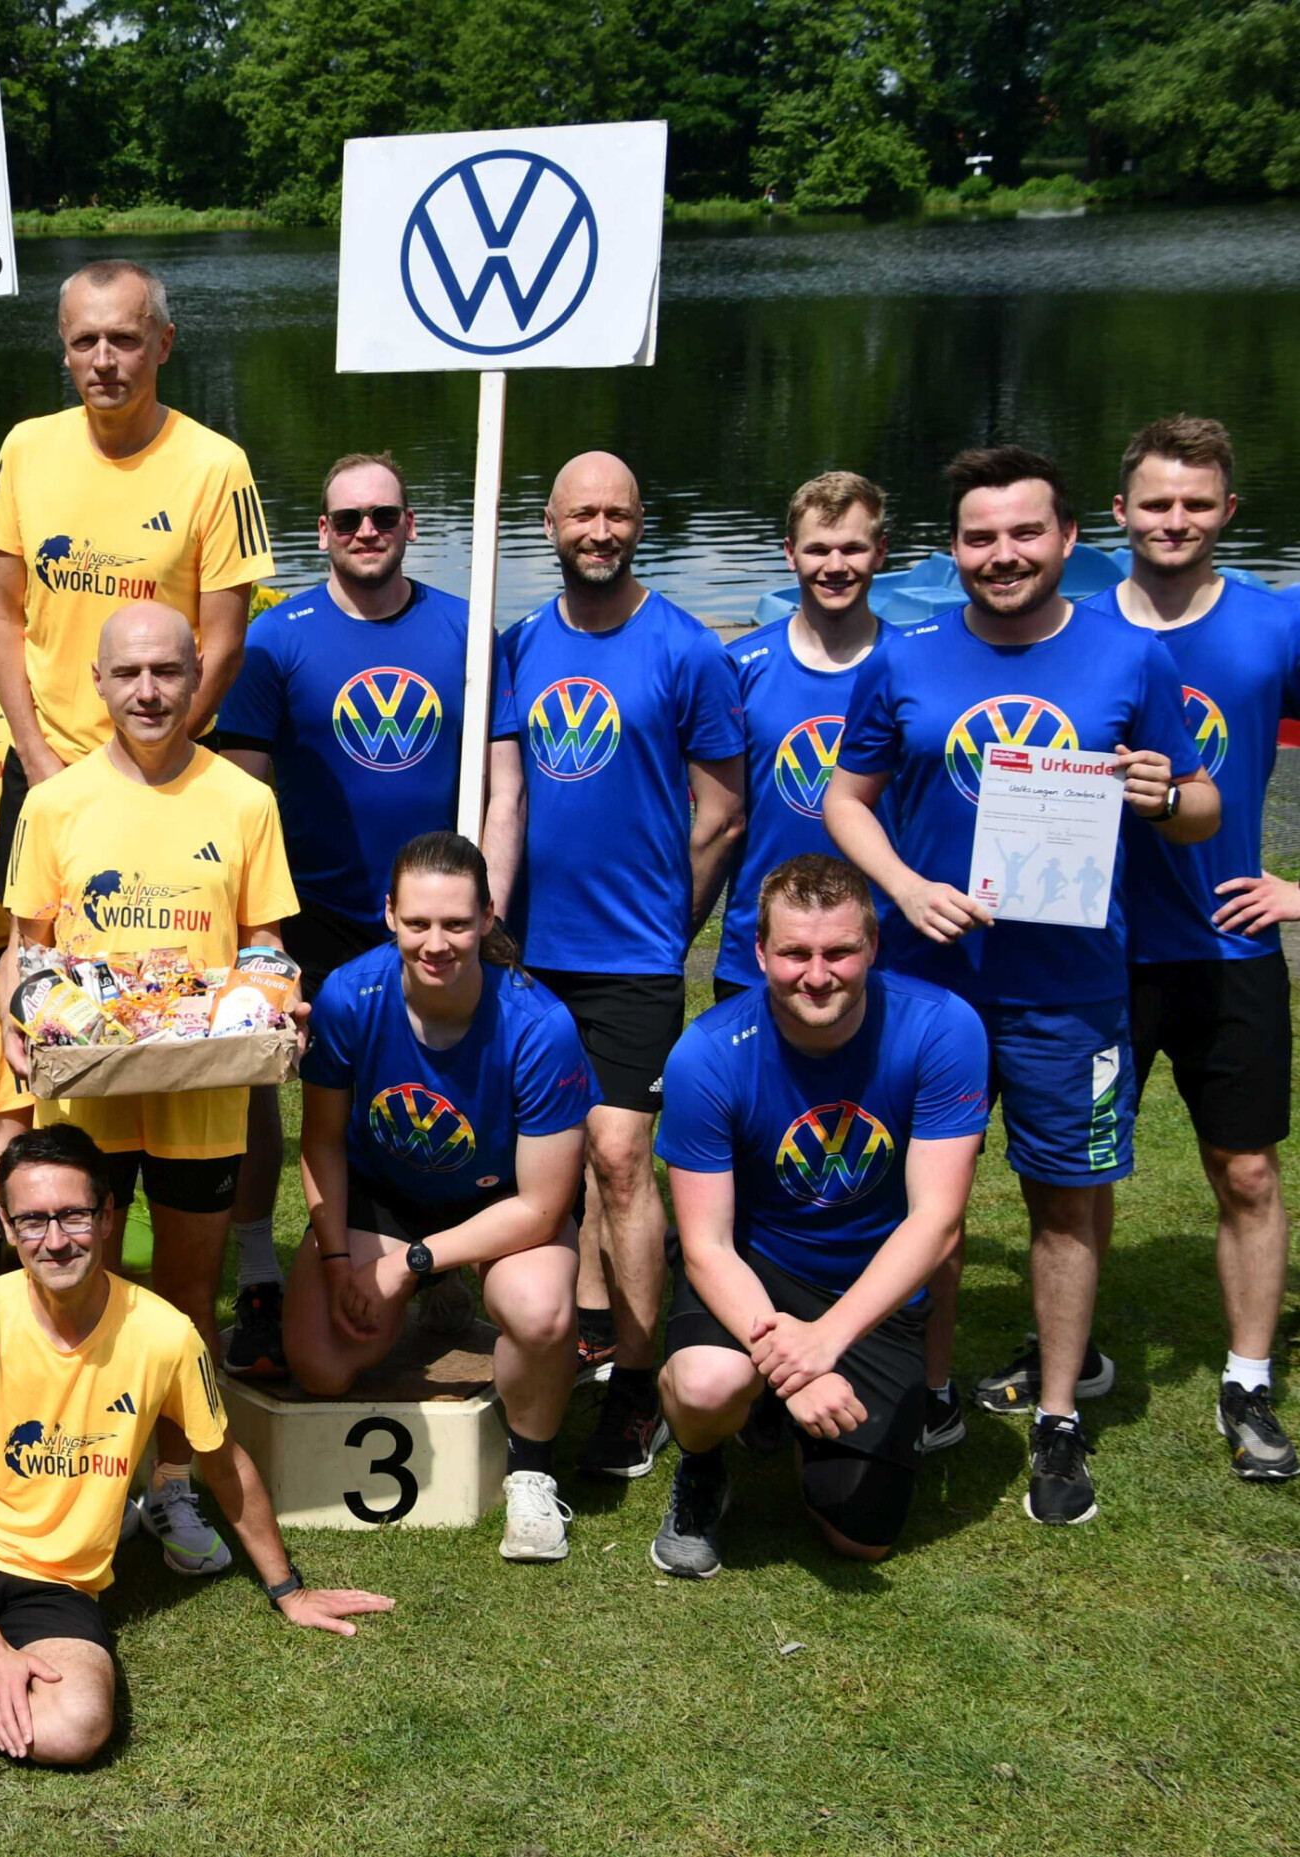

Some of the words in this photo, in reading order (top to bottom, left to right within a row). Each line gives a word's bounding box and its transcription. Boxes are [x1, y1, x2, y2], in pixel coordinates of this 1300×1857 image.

[404, 153, 596, 350] VW
[70, 550, 117, 565] WINGS
[53, 569, 116, 597] WORLD
[118, 577, 158, 601] RUN
[1041, 757, 1116, 777] Urkunde
[1039, 803, 1046, 813] 3
[121, 884, 171, 898] WINGS
[103, 905, 171, 931] WORLD
[174, 909, 213, 933] RUN
[240, 957, 289, 975] Aoste
[24, 977, 53, 1021] Aoste
[26, 1453, 90, 1478] WORLD
[92, 1453, 128, 1478] RUN
[342, 1415, 419, 1525] 3
